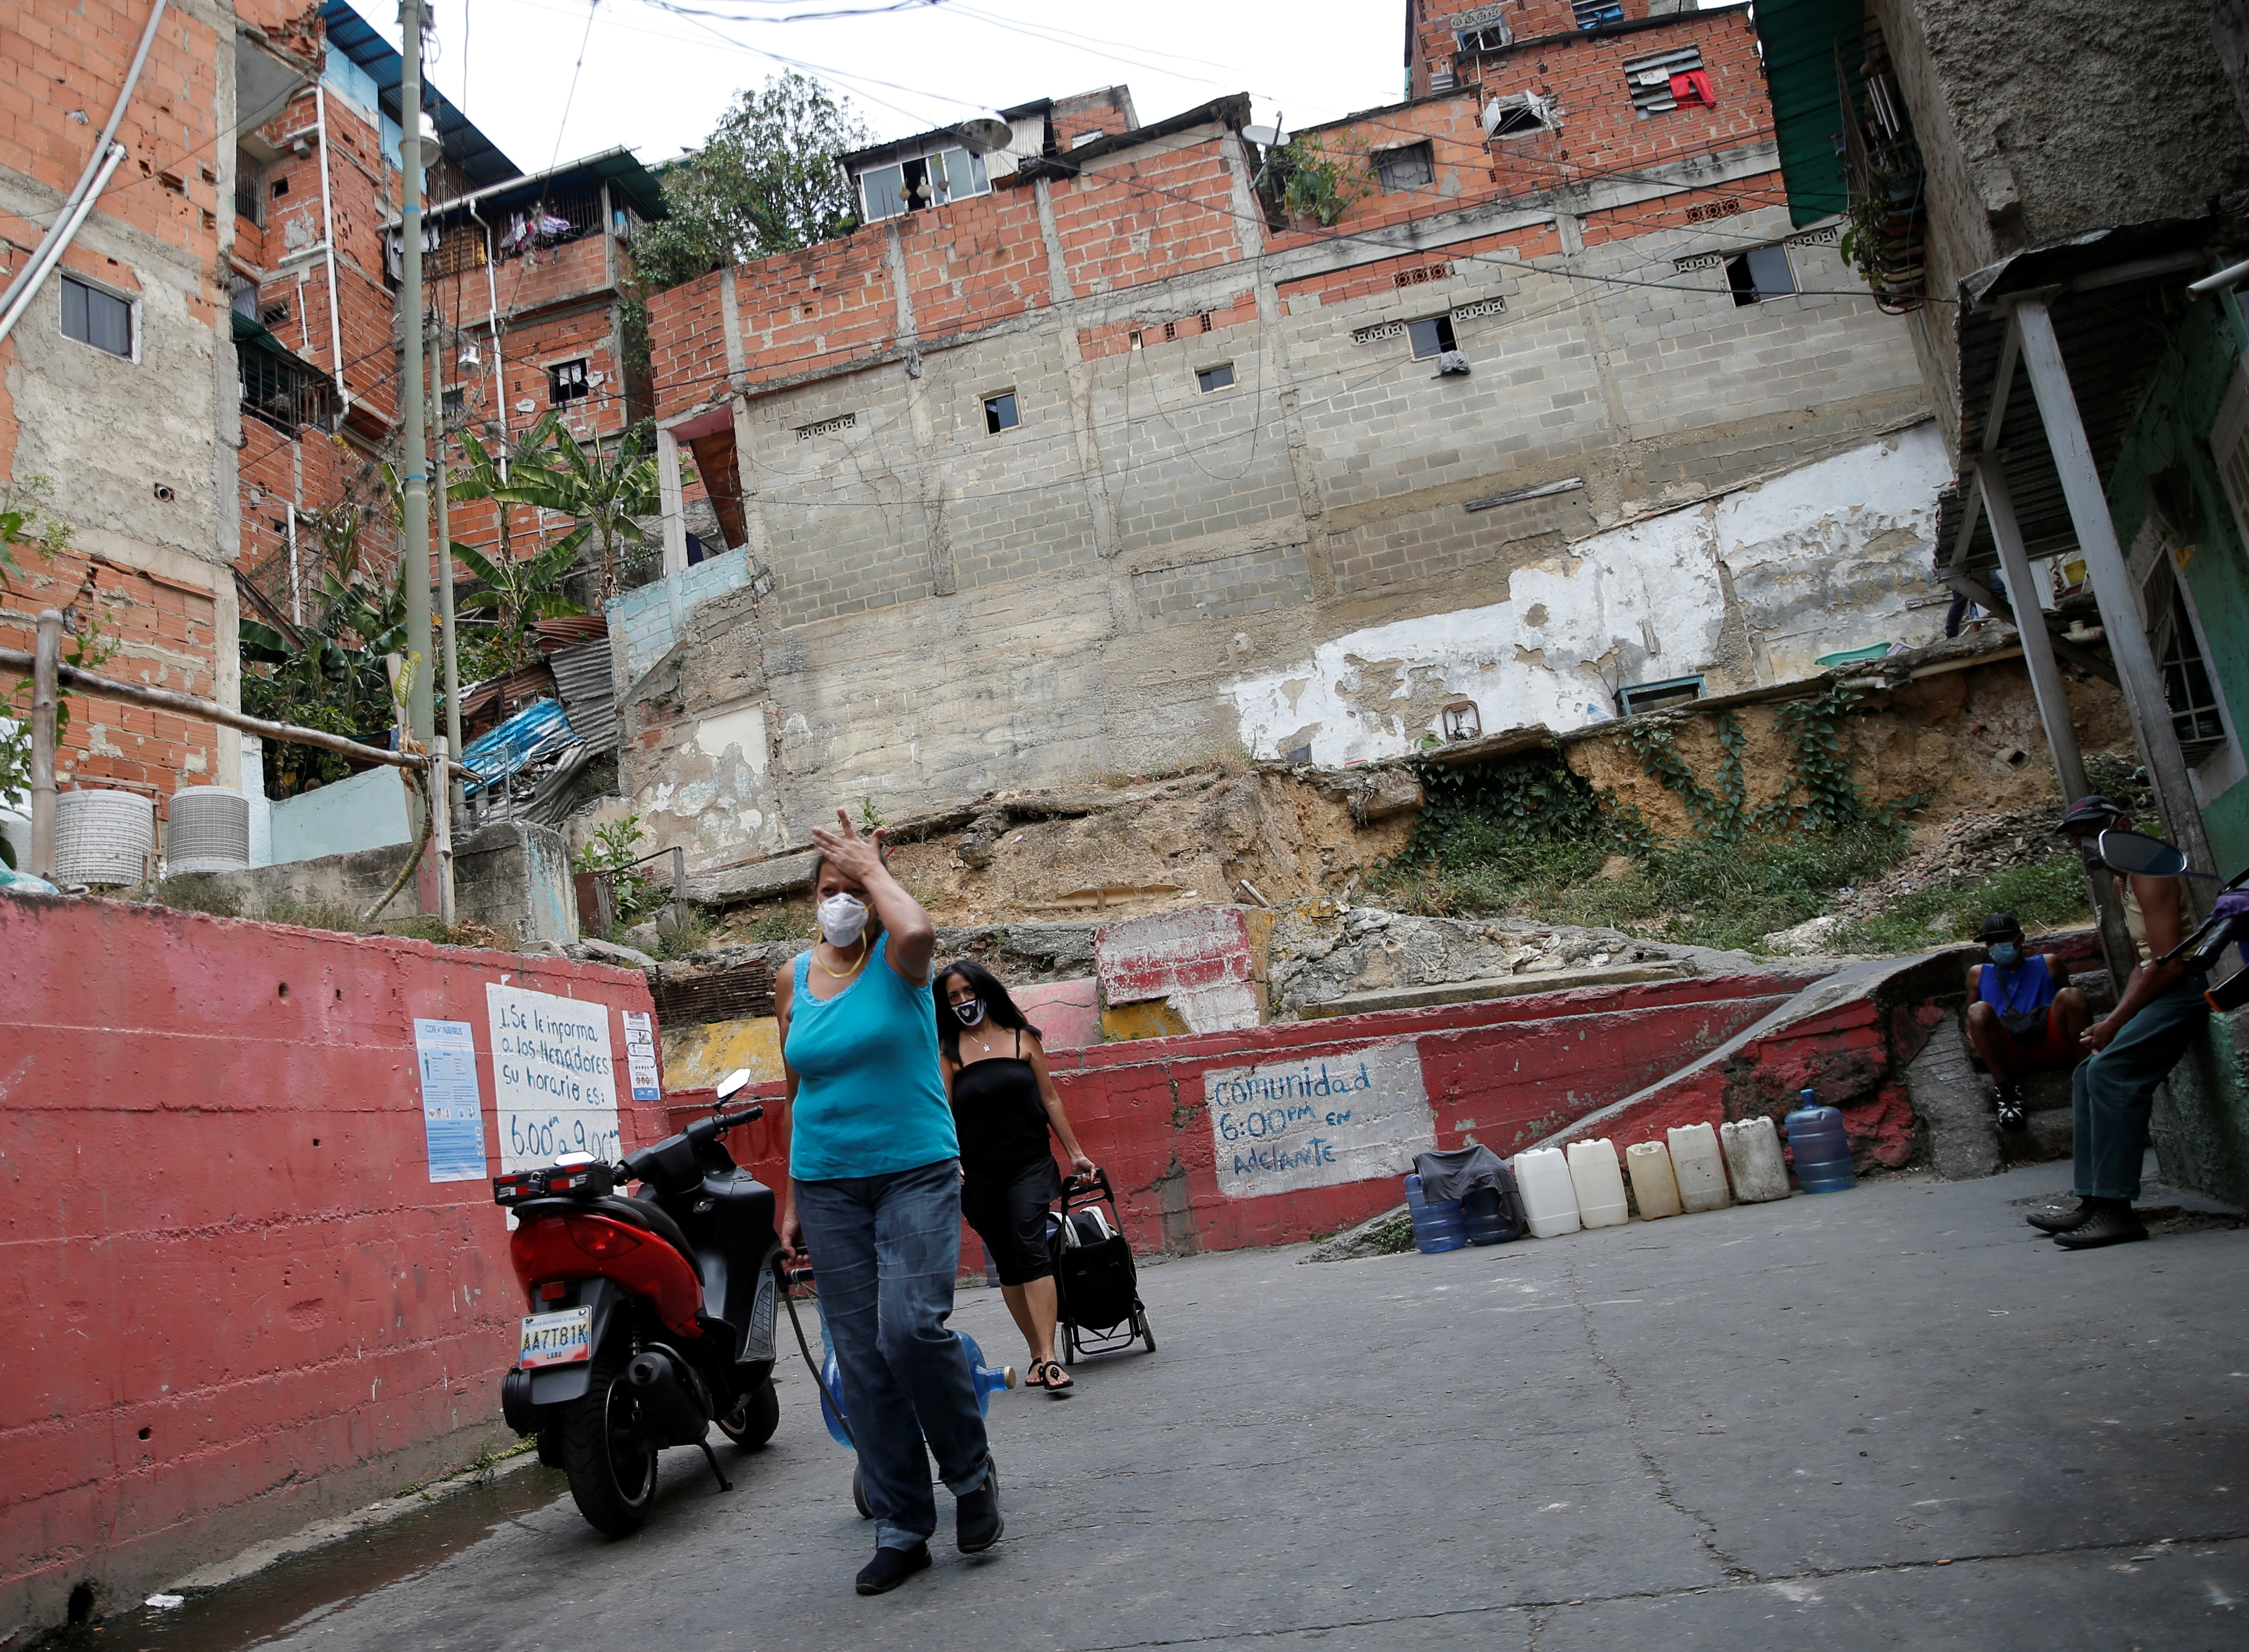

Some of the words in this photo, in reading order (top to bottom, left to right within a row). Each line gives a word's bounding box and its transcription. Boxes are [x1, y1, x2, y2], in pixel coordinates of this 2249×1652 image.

[547, 1015, 599, 1043] informa
[502, 1037, 513, 1052] a
[517, 1036, 536, 1059] los
[527, 1066, 580, 1101] horario
[558, 1139, 571, 1154] a
[524, 1323, 587, 1351] AA7T81K
[547, 1351, 562, 1359] LARA
